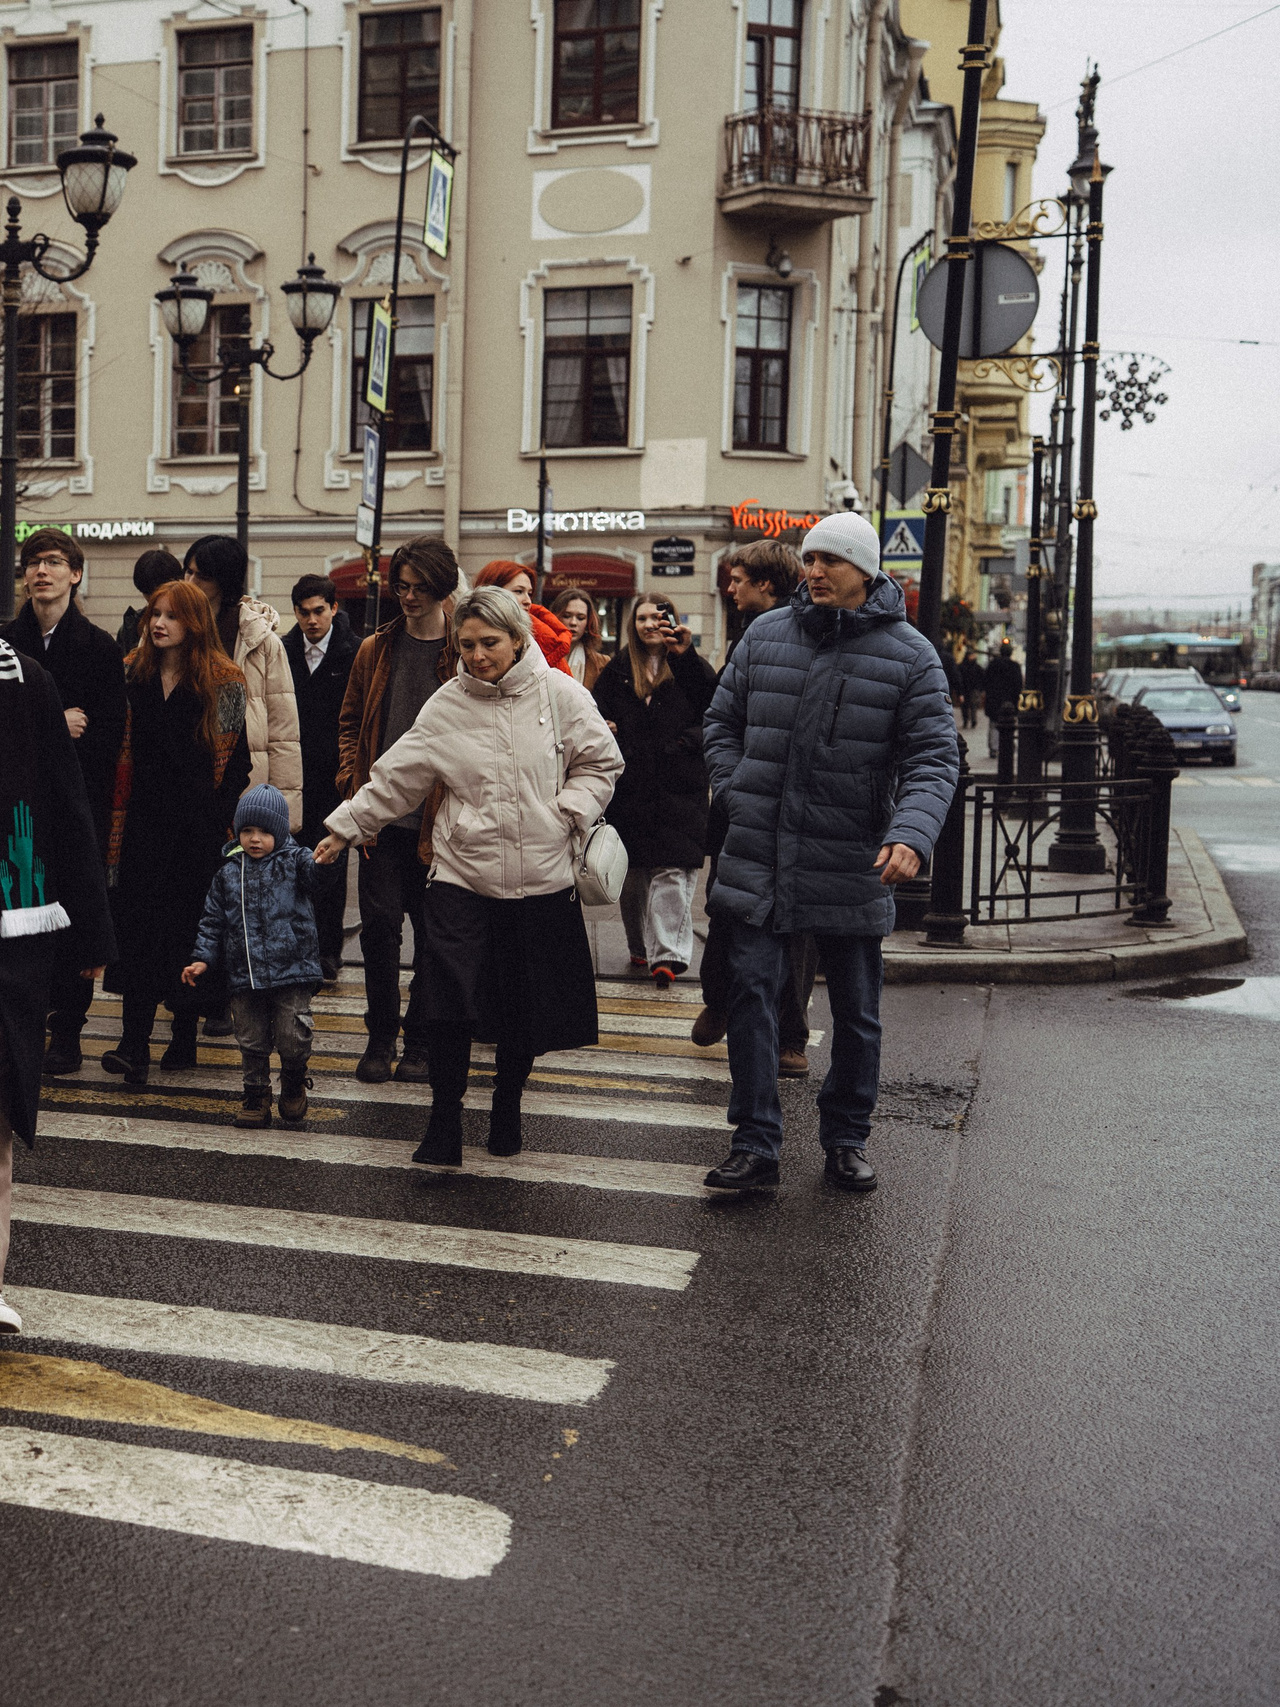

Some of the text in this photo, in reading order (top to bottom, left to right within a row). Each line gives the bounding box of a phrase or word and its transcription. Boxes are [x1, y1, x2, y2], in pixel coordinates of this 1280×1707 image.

[507, 508, 645, 532] Винотека
[731, 498, 820, 537] Vinissimo
[76, 521, 155, 540] ПОДАРКИ
